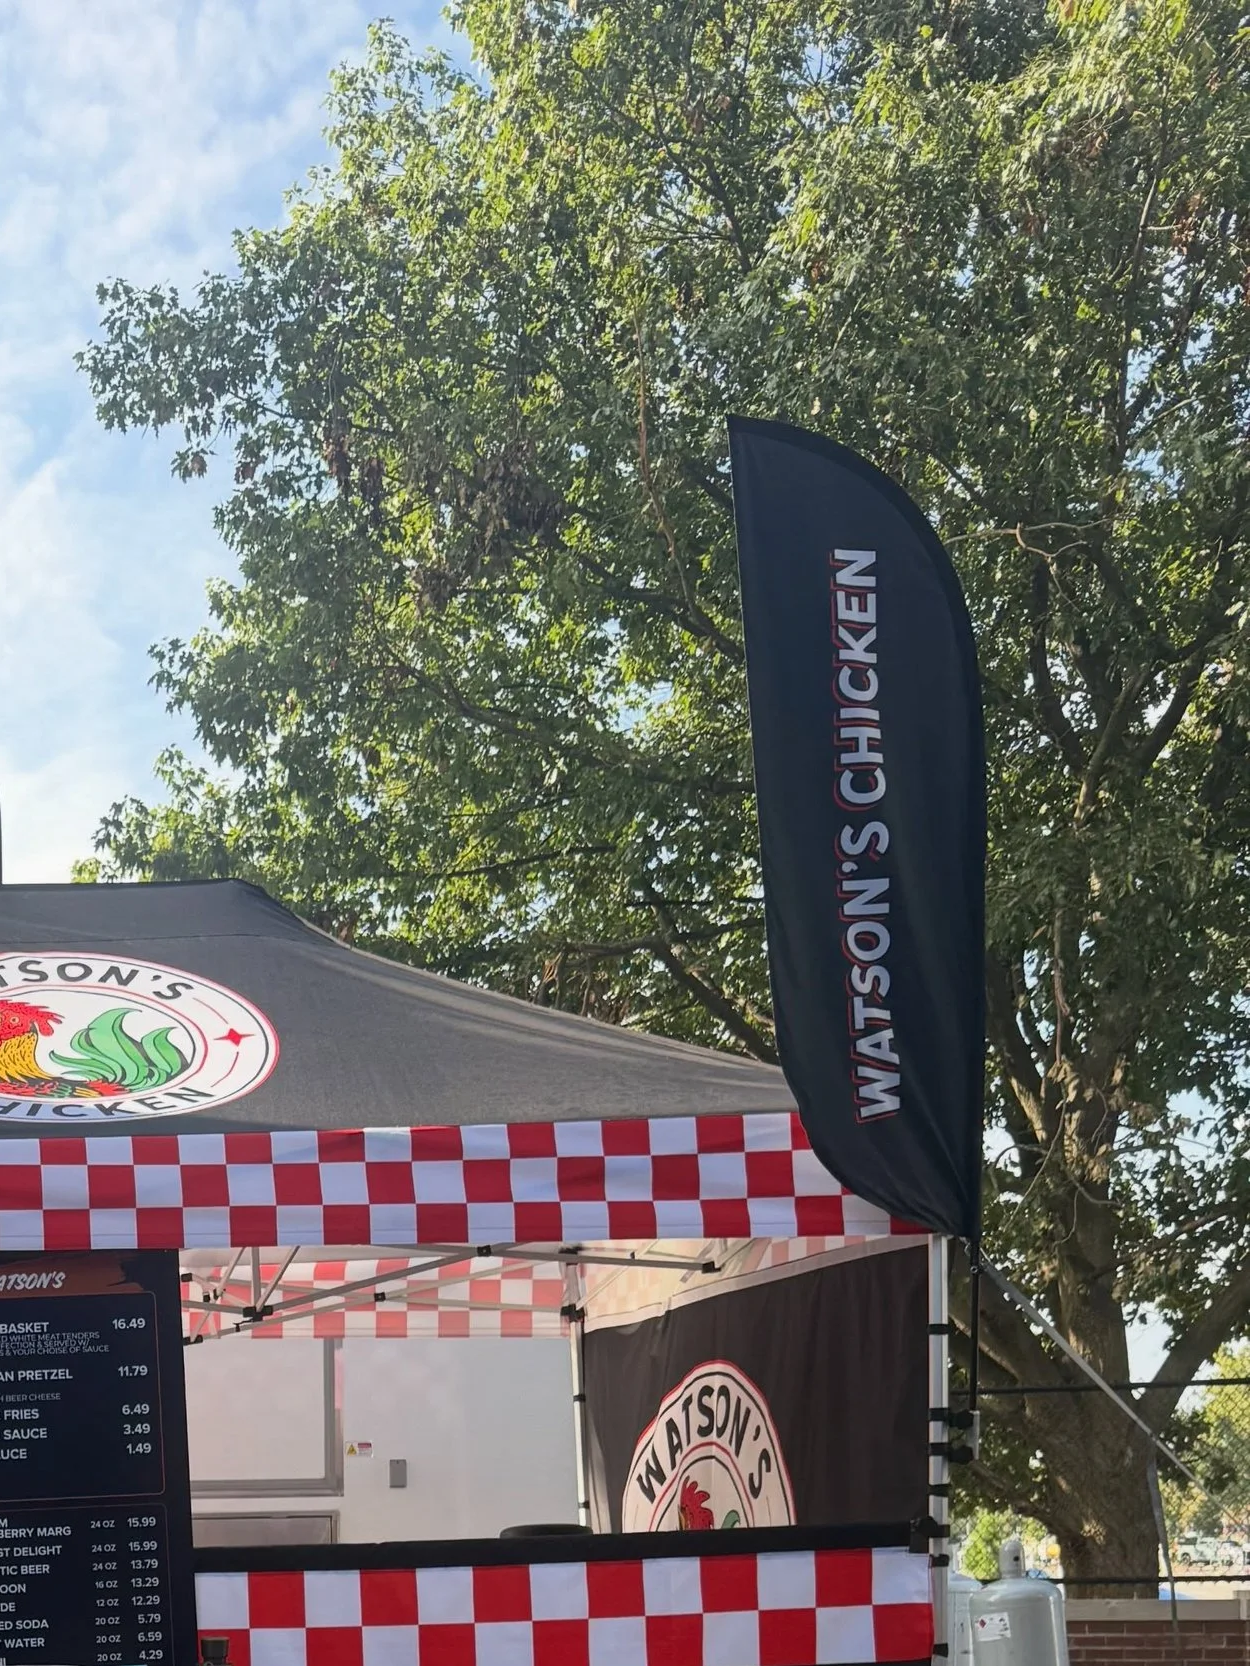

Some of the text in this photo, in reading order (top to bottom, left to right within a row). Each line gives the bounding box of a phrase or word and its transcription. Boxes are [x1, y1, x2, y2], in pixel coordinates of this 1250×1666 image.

[832, 548, 901, 1120] WATSON'S CHICKEN
[0, 1322, 49, 1334] BASKET
[112, 1318, 146, 1330] 16.49
[62, 1332, 100, 1340] TENDERS
[12, 1348, 36, 1356] YOUR
[82, 1345, 110, 1353] SAUCE
[44, 1340, 76, 1348] SERVED
[18, 1369, 73, 1381] PRETZEL
[117, 1365, 148, 1377] 11.79
[6, 1394, 28, 1402] BEER
[29, 1392, 61, 1401] CHEESE
[4, 1409, 40, 1421] FRIES
[122, 1404, 150, 1416] 6.49
[4, 1428, 48, 1440] SAUCE
[123, 1424, 151, 1435] 3.49
[126, 1443, 152, 1454] 1.49
[636, 1385, 771, 1504] WATSON'S
[90, 1521, 101, 1529] 24
[102, 1520, 115, 1528] OZ
[127, 1517, 156, 1527] 15.99
[37, 1526, 71, 1537] MARG
[13, 1545, 62, 1557] DELIGHT
[92, 1545, 102, 1553] 24
[103, 1544, 116, 1552] OZ
[128, 1541, 158, 1551] 15.99
[20, 1564, 50, 1575] BEER
[92, 1563, 103, 1571] 24
[104, 1562, 117, 1570] OZ
[130, 1559, 158, 1569] 13.79
[106, 1580, 118, 1588] OZ
[130, 1577, 159, 1588] 13.29
[96, 1599, 105, 1607] 12
[106, 1598, 119, 1606] OZ
[131, 1596, 160, 1606] 12.29
[15, 1619, 49, 1630] SODA
[95, 1617, 106, 1625] 20
[108, 1616, 120, 1624] OZ
[137, 1614, 161, 1624] 5.79
[4, 1638, 45, 1648] WATER
[96, 1636, 107, 1644] 20
[108, 1635, 121, 1643] OZ
[138, 1632, 162, 1642] 6.59
[97, 1654, 108, 1662] 20
[110, 1653, 122, 1661] OZ
[139, 1650, 163, 1660] 4.29
